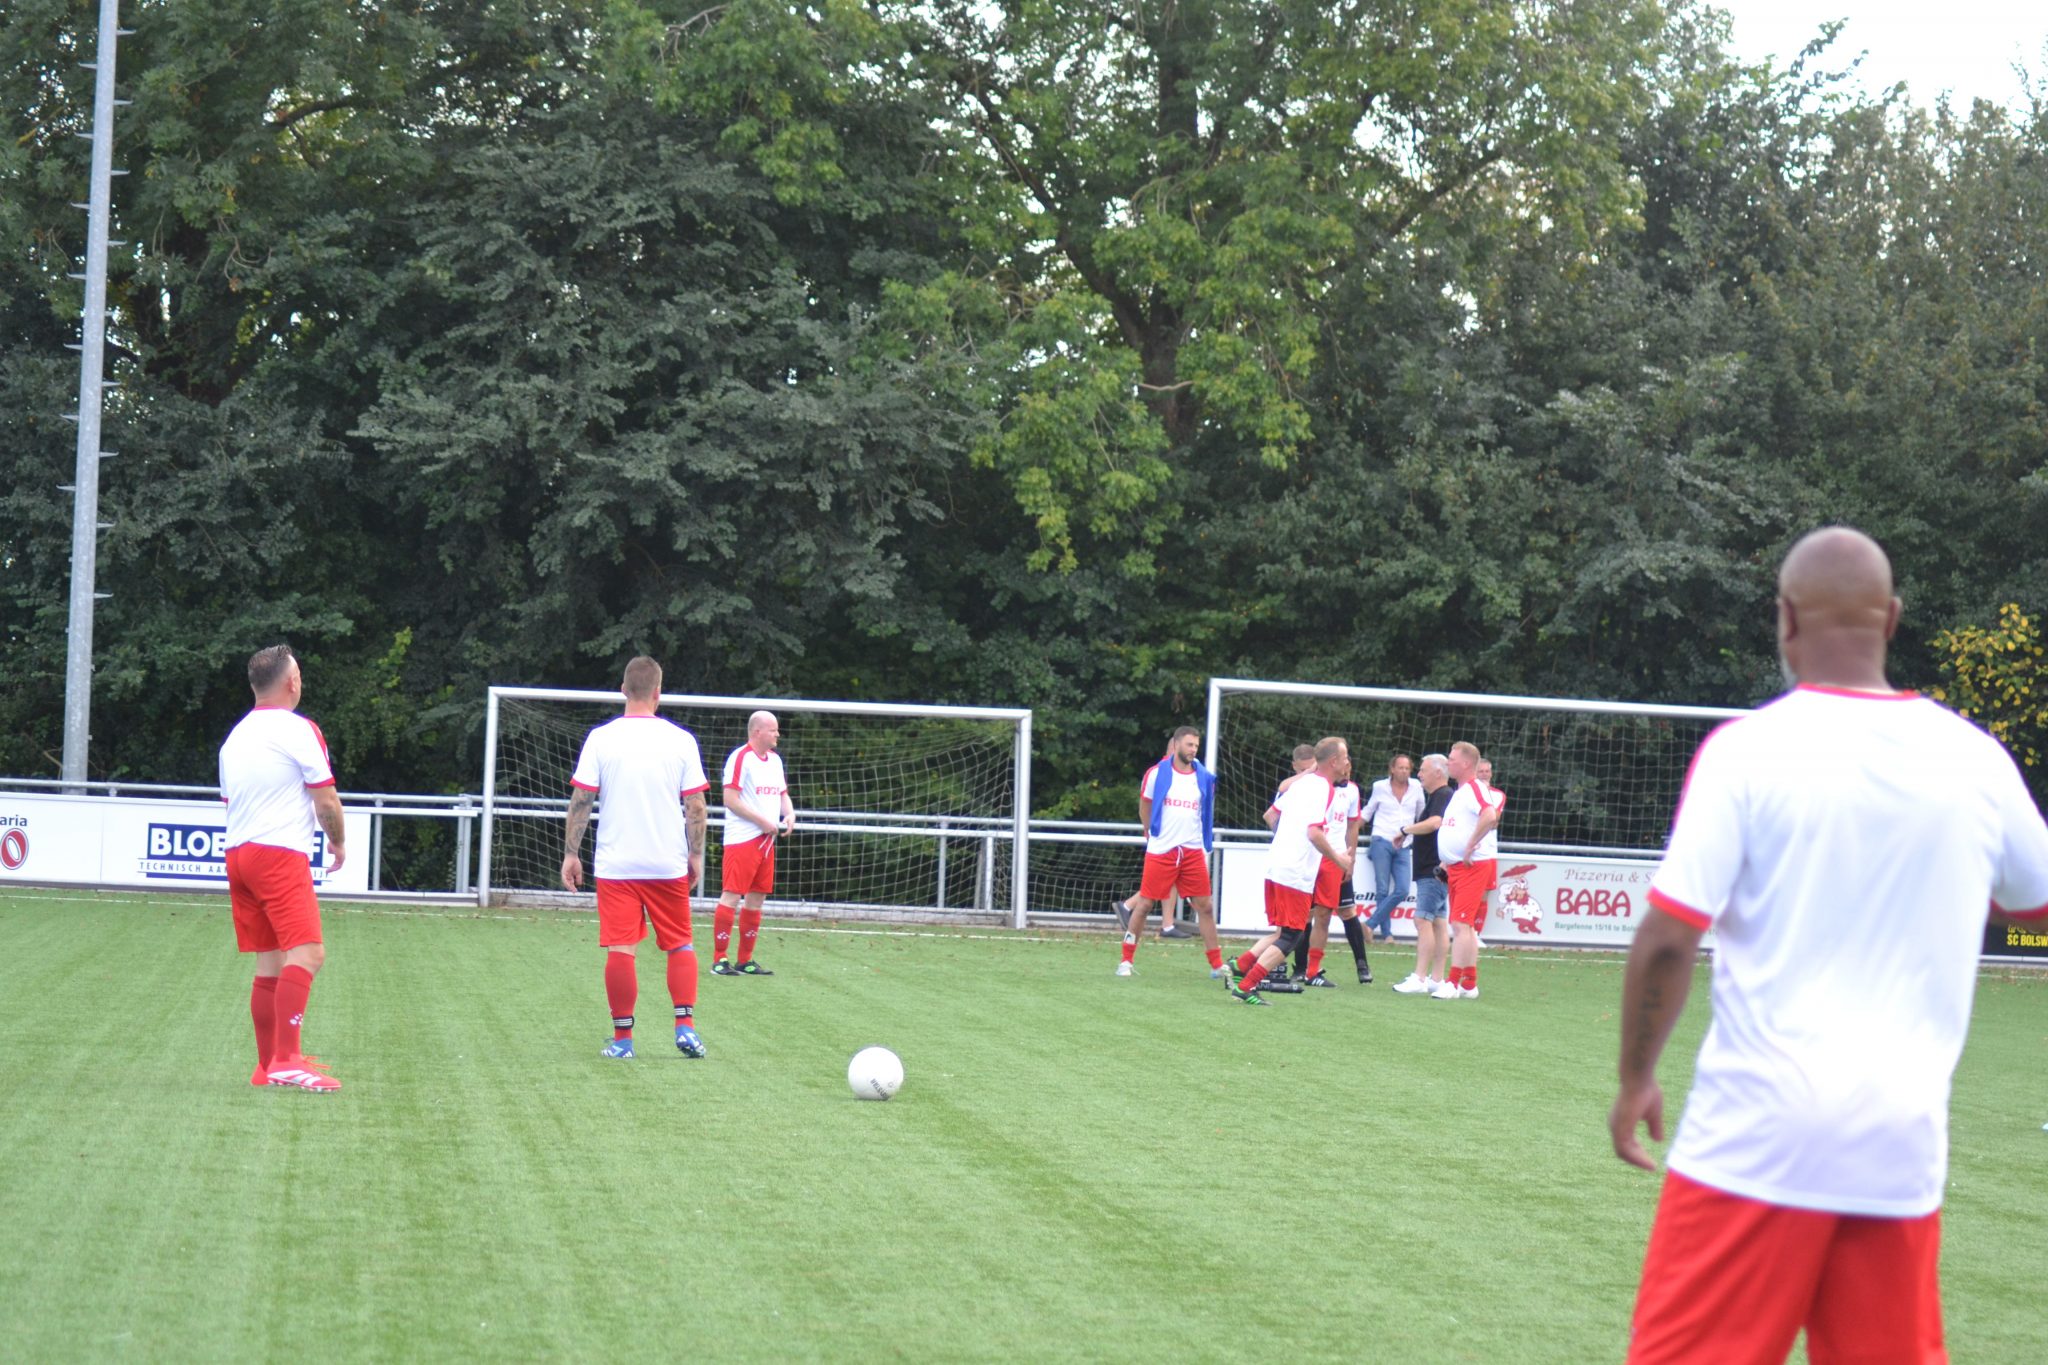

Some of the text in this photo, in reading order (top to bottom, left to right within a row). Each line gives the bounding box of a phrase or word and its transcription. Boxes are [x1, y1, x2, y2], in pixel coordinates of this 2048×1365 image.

[139, 861, 201, 873] TECHNISCH
[1564, 867, 1655, 884] Pizzeria & S
[1556, 888, 1631, 917] BABA
[2007, 934, 2019, 946] SC
